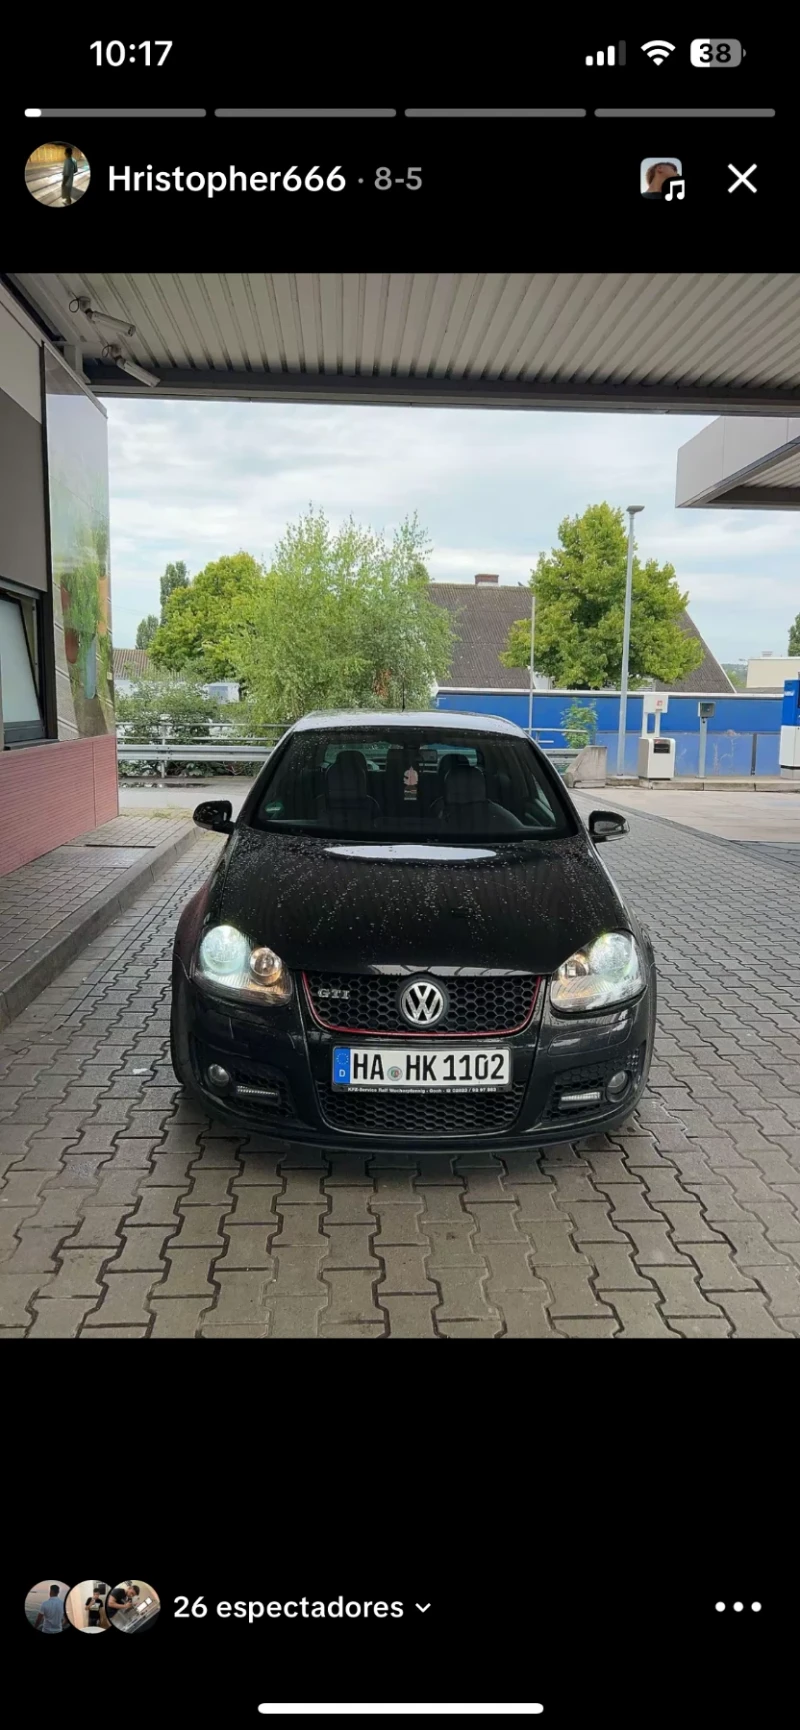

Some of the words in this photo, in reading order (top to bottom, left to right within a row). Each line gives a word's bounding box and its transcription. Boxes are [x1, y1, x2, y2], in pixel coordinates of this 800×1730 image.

[317, 988, 350, 1000] GTI
[339, 1069, 345, 1077] D
[353, 1053, 385, 1080] HA
[406, 1054, 437, 1081] HK
[443, 1054, 504, 1081] 1102
